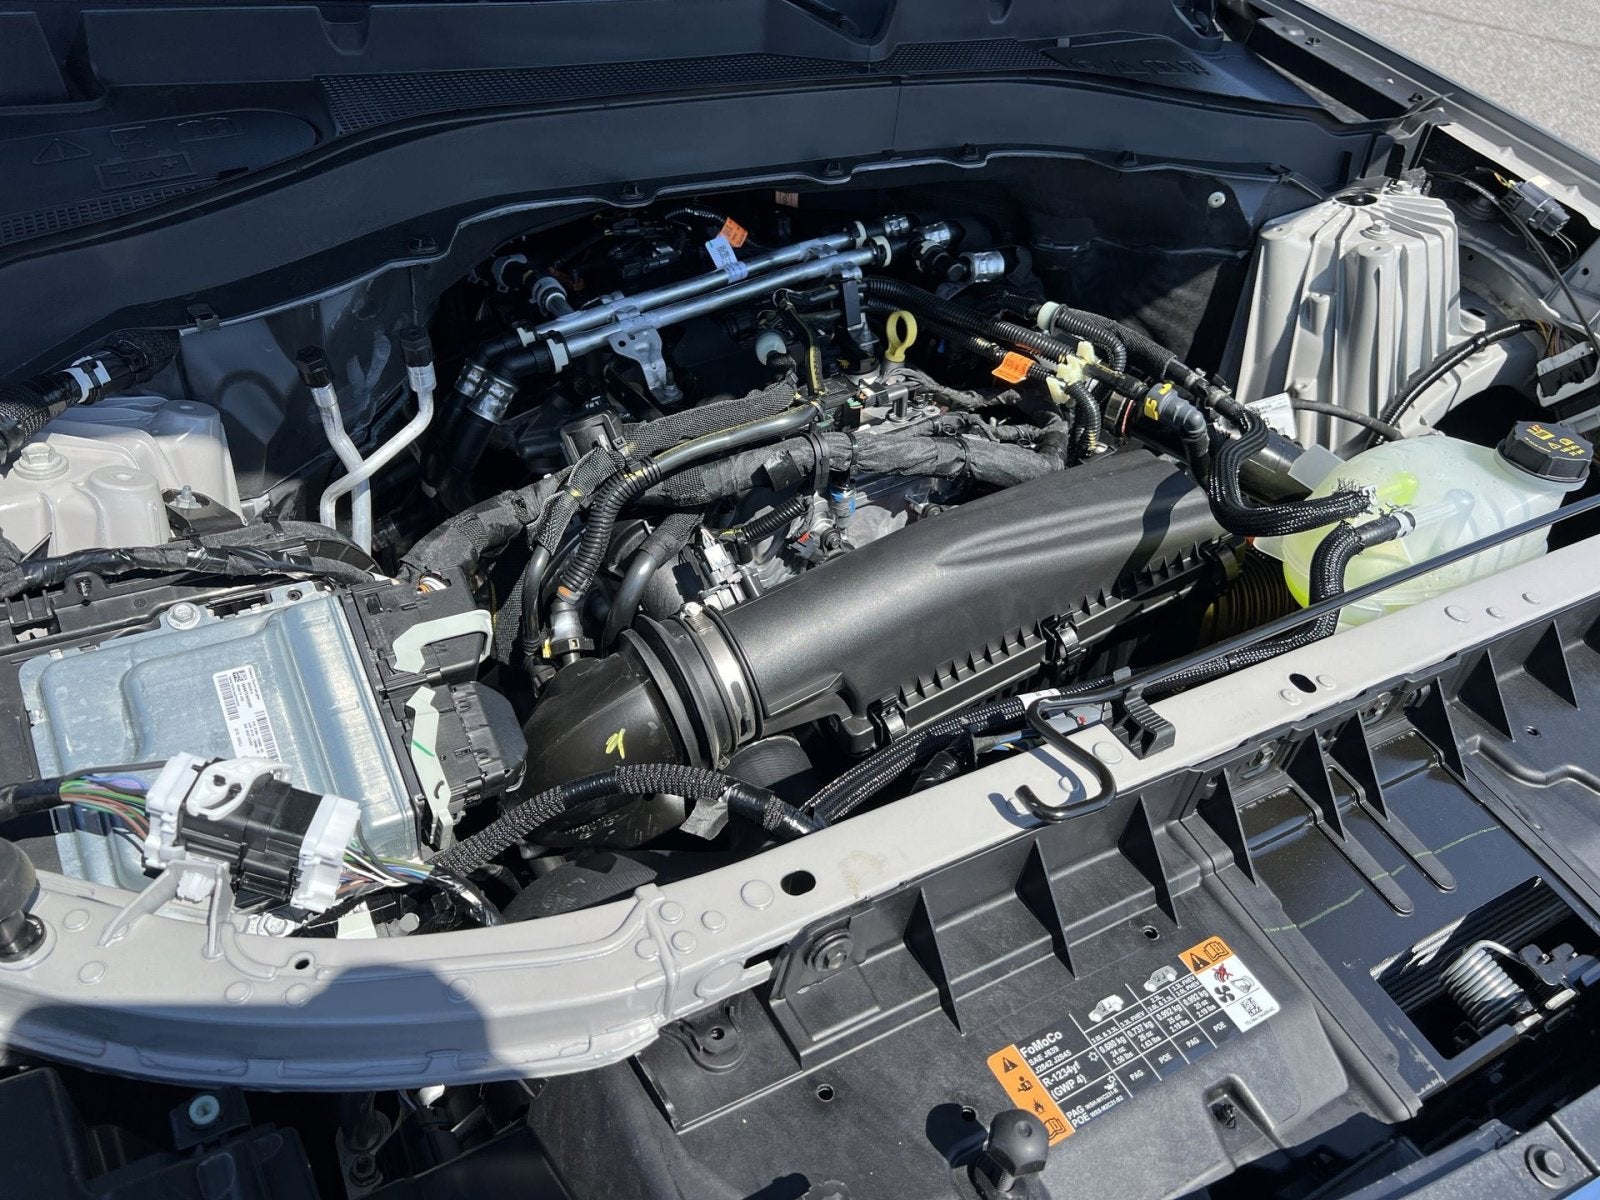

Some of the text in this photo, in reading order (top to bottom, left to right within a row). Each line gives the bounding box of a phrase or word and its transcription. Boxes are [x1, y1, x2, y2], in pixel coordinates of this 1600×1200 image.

[1183, 993, 1200, 1006] 0.992
[1156, 1004, 1182, 1020] 0.992 kg
[1127, 1021, 1154, 1037] 0.737 kg
[1213, 1022, 1226, 1032] POE
[1020, 1032, 1062, 1058] FoMoCo
[1099, 1036, 1127, 1053] 0.680 kg
[1186, 1037, 1199, 1047] PAG
[1028, 1046, 1059, 1065] SAE J639
[1113, 1056, 1125, 1065] 1.50
[1159, 1053, 1172, 1063] POE
[1042, 1061, 1080, 1087] R-1234yf
[1130, 1070, 1144, 1080] PAG
[1051, 1074, 1087, 1100] (GWP 4)
[1066, 1106, 1084, 1120] PAG
[1072, 1112, 1090, 1127] POE
